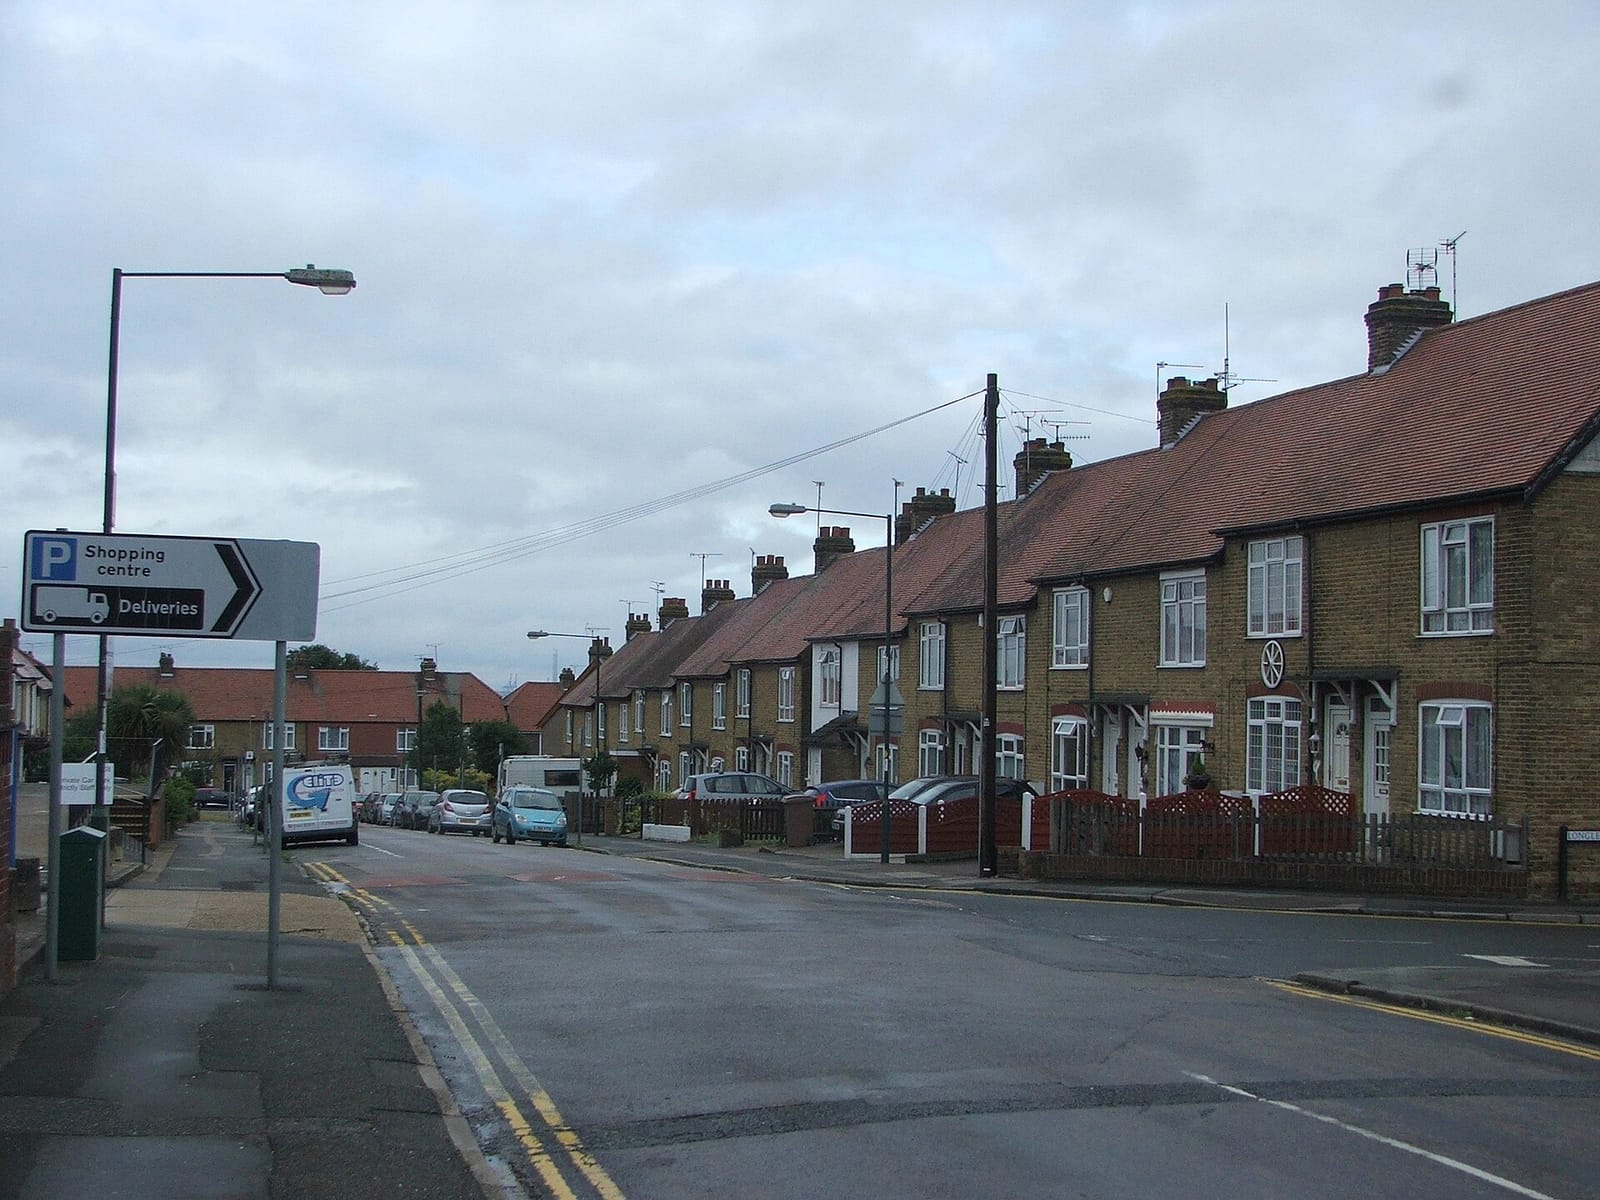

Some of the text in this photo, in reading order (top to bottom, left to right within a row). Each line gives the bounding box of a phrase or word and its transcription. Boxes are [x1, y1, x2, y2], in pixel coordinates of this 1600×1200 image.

[41, 540, 72, 578] P
[85, 545, 165, 563] Shopping
[97, 564, 151, 577] centre
[119, 599, 199, 616] Deliveries
